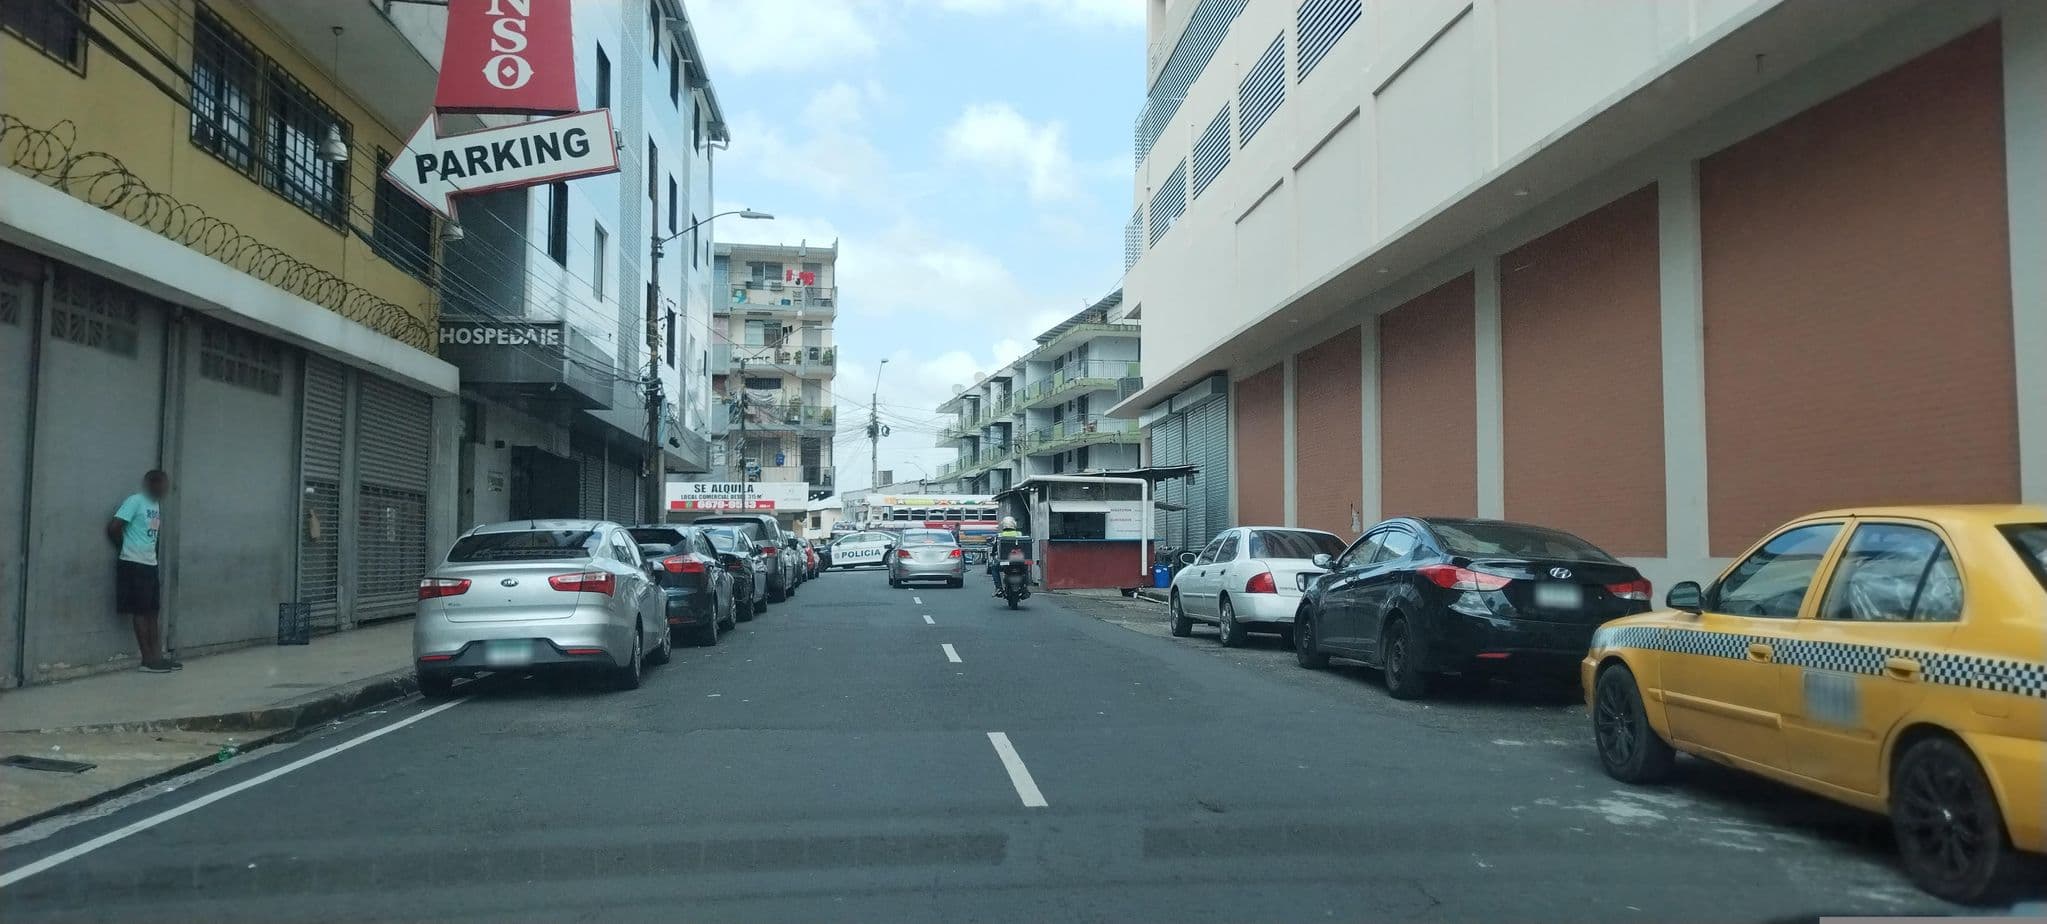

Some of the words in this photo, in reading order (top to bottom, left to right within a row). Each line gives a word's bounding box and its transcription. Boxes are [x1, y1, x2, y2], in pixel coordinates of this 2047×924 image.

[415, 127, 591, 185] PARKING
[694, 484, 706, 493] SE
[842, 548, 881, 558] POLICIA
